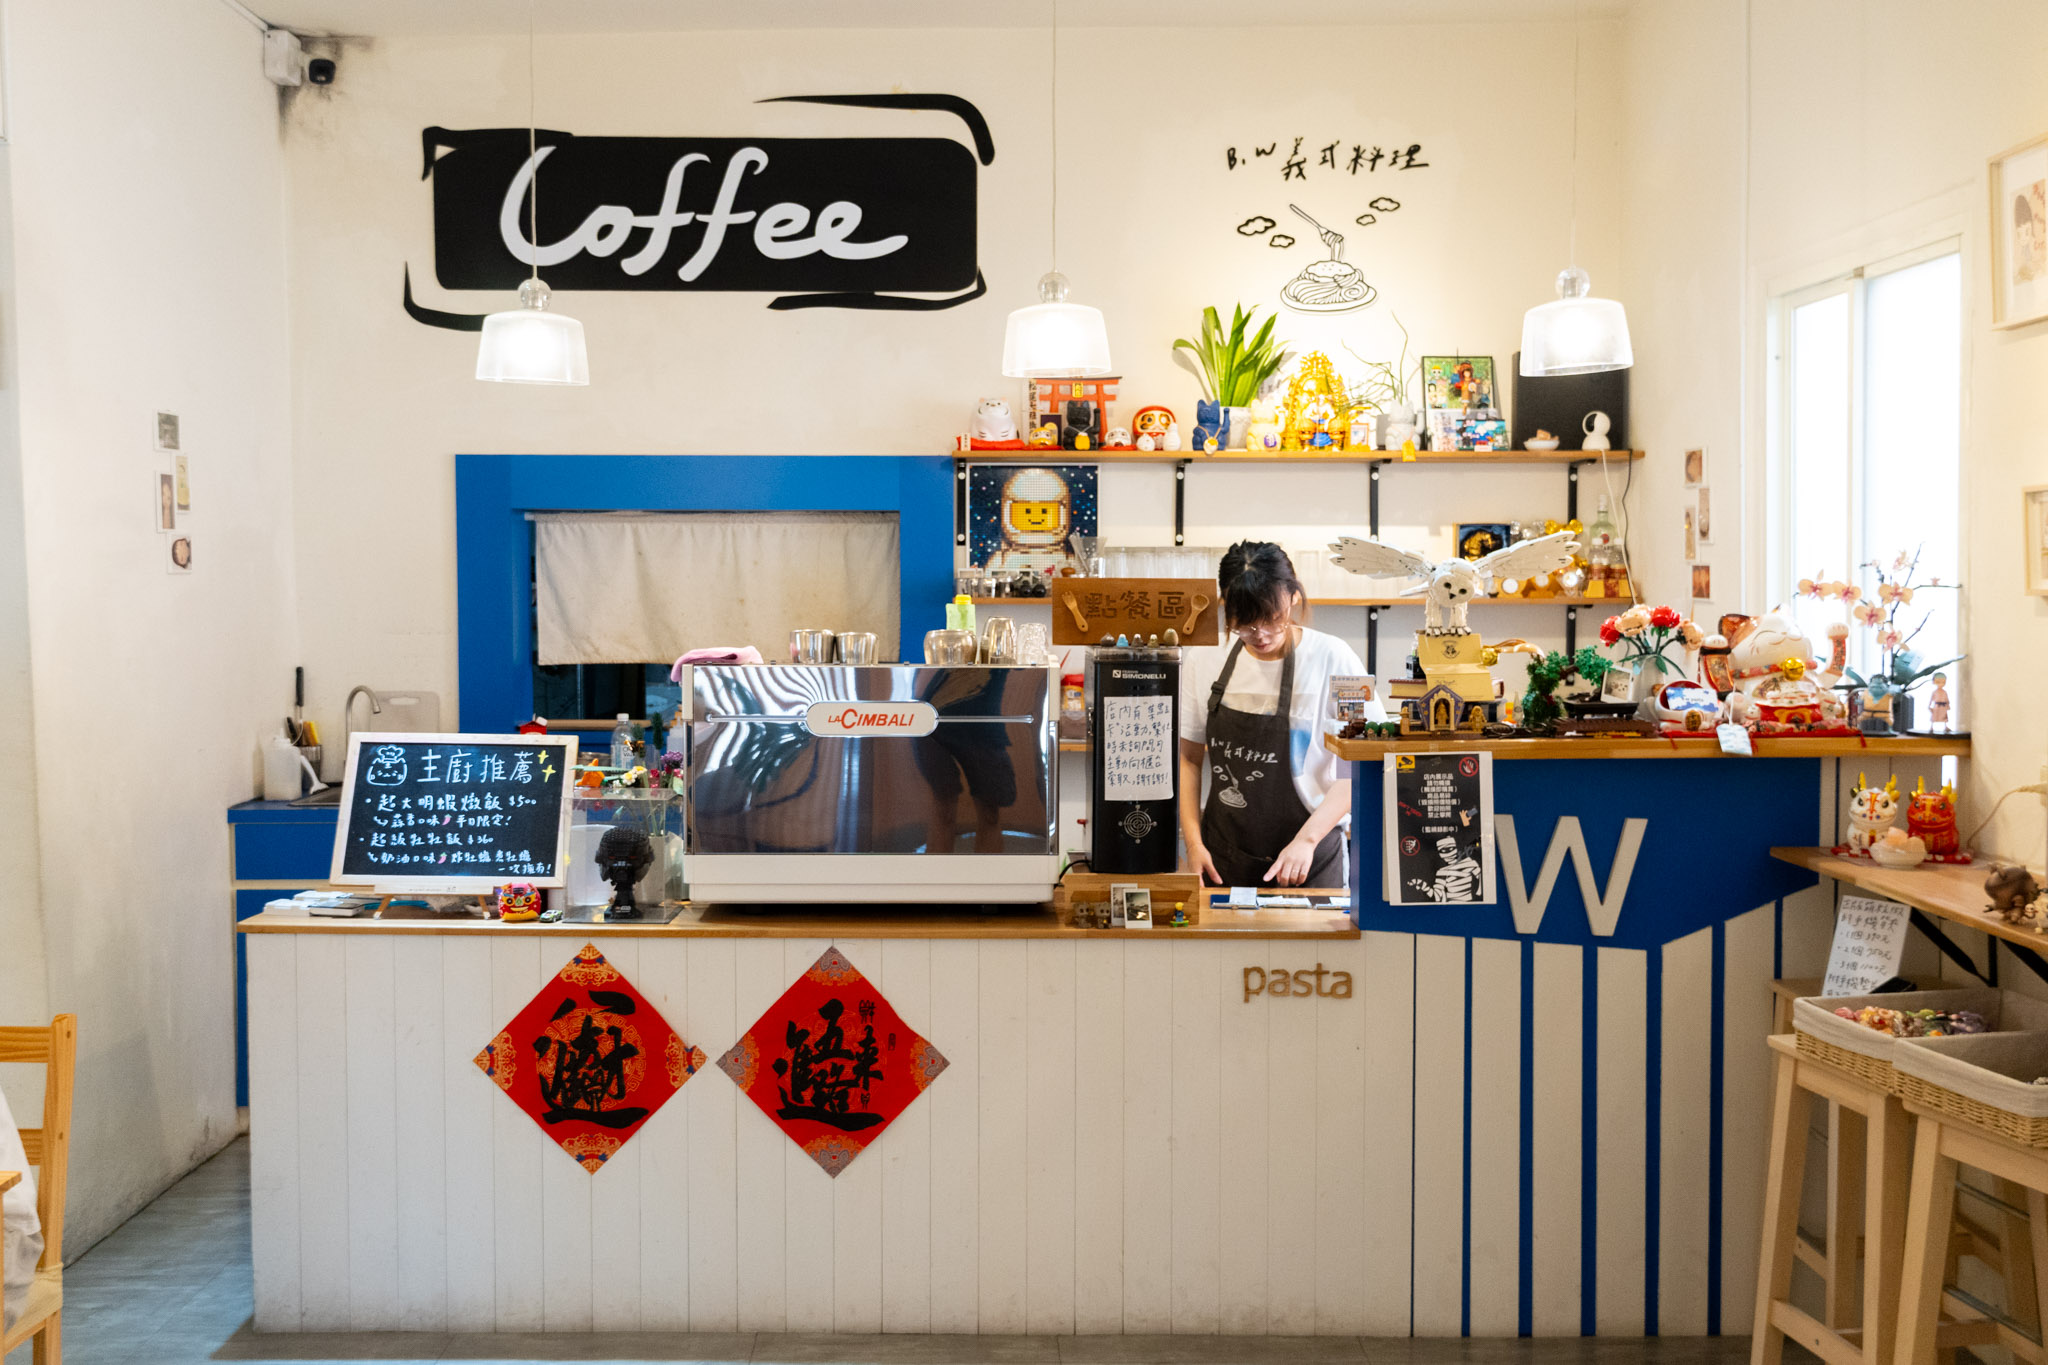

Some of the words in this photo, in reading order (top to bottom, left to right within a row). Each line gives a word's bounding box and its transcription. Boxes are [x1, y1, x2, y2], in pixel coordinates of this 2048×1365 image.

[499, 145, 909, 282] Coffee
[1085, 590, 1185, 619] 點餐區
[841, 708, 915, 729] CIMBALI
[417, 749, 533, 784] 主廚推薦
[1243, 963, 1353, 1004] pasta
